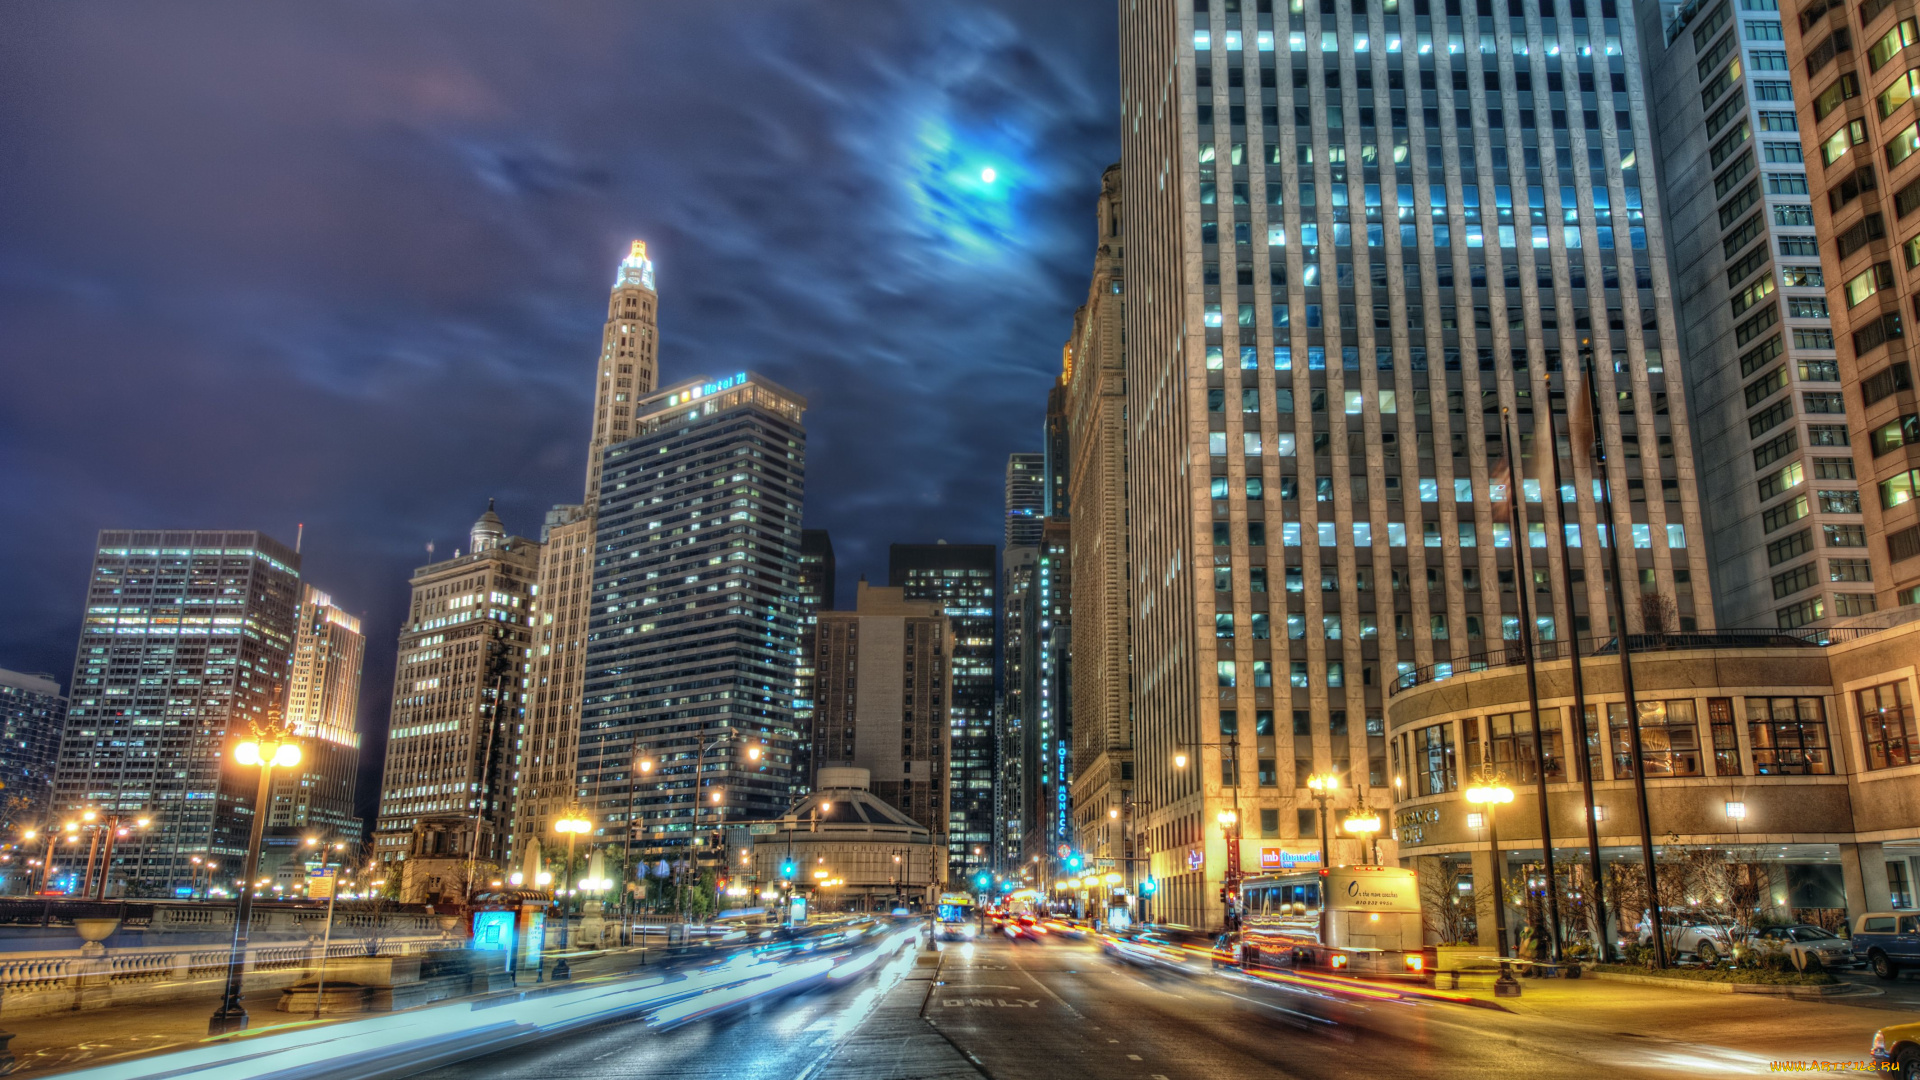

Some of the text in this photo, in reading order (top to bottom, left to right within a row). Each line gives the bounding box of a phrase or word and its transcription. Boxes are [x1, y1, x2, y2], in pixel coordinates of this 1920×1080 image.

[704, 372, 746, 395] Hotel 71
[1058, 740, 1067, 835] HOTEL MONACO
[1263, 850, 1321, 863] mb financial
[942, 999, 1040, 1008] ONLY
